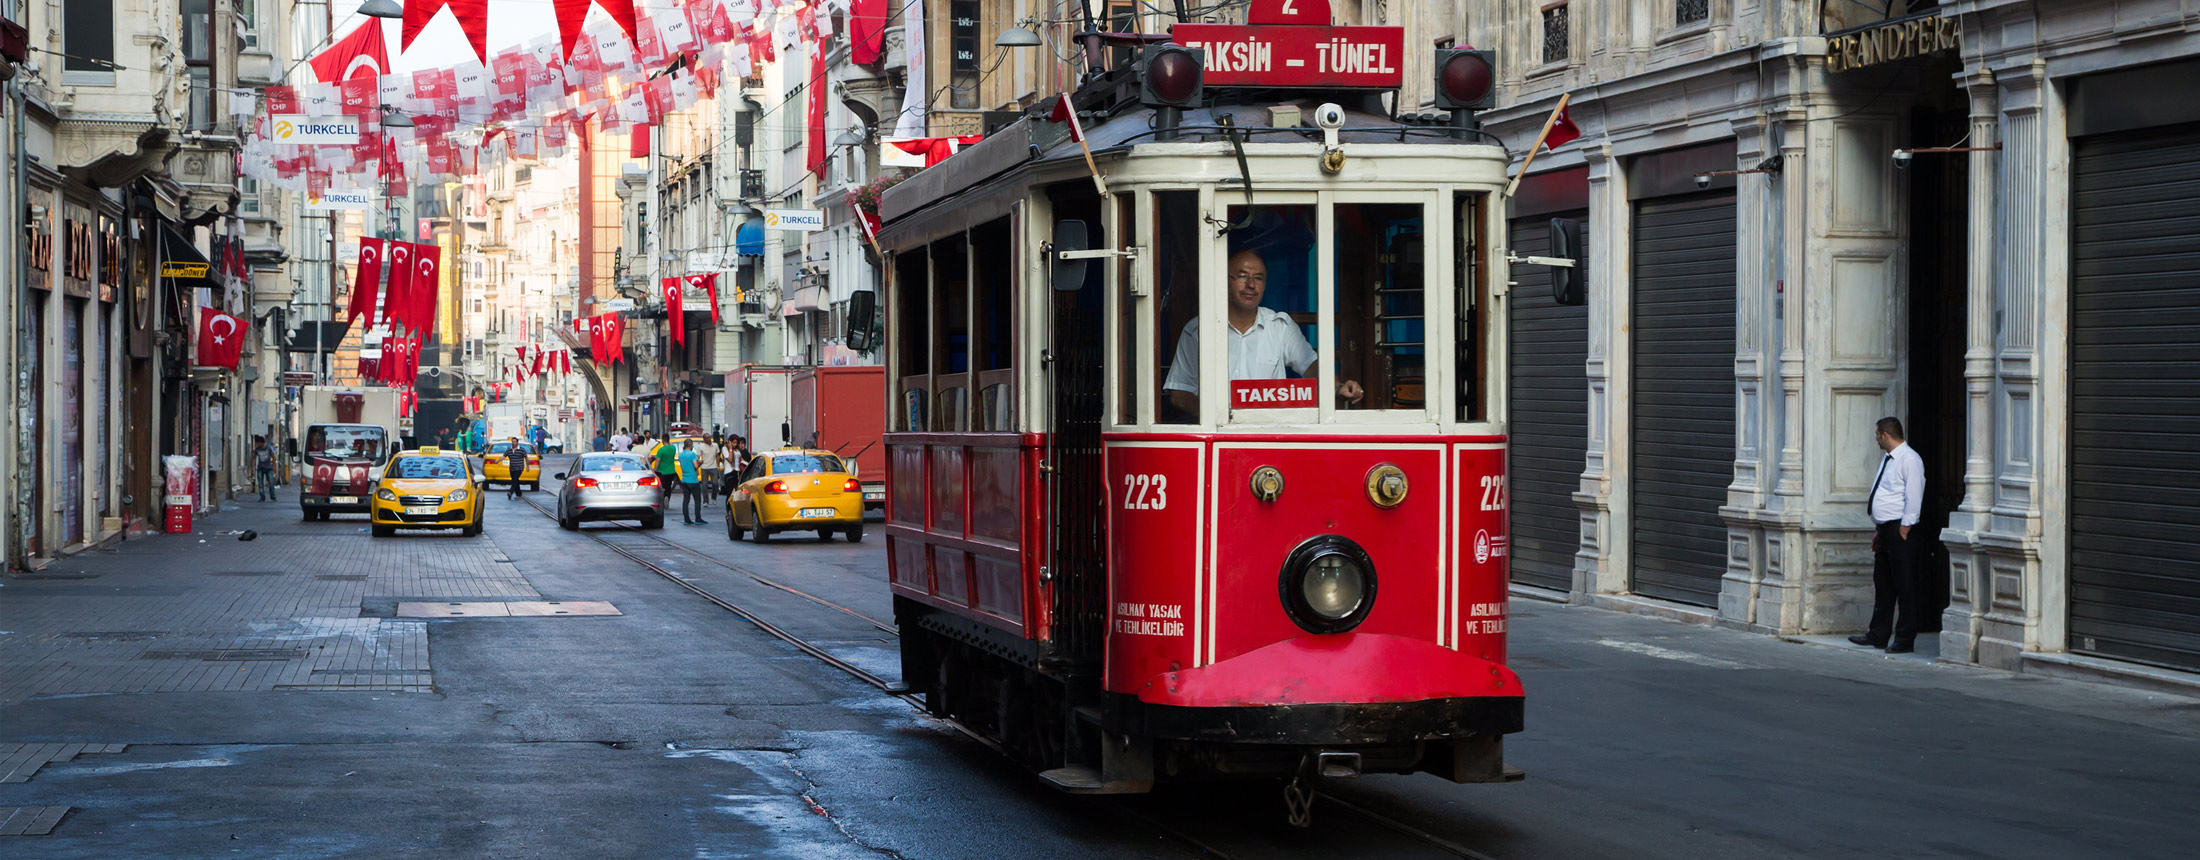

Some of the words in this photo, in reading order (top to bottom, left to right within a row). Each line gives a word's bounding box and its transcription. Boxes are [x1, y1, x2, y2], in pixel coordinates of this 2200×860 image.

[668, 23, 682, 32] CHP
[1316, 38, 1394, 74] TÜNEL
[500, 75, 516, 83] CHP
[298, 124, 358, 134] TURKCELL
[324, 194, 368, 204] TURKCELL
[782, 216, 822, 224] TURKCELL
[1236, 384, 1312, 402] TAKSİM
[1124, 474, 1167, 510] 223
[1149, 604, 1182, 618] YASAK
[1124, 620, 1184, 636] TEHLİKELİDİR
[1466, 620, 1478, 634] VE
